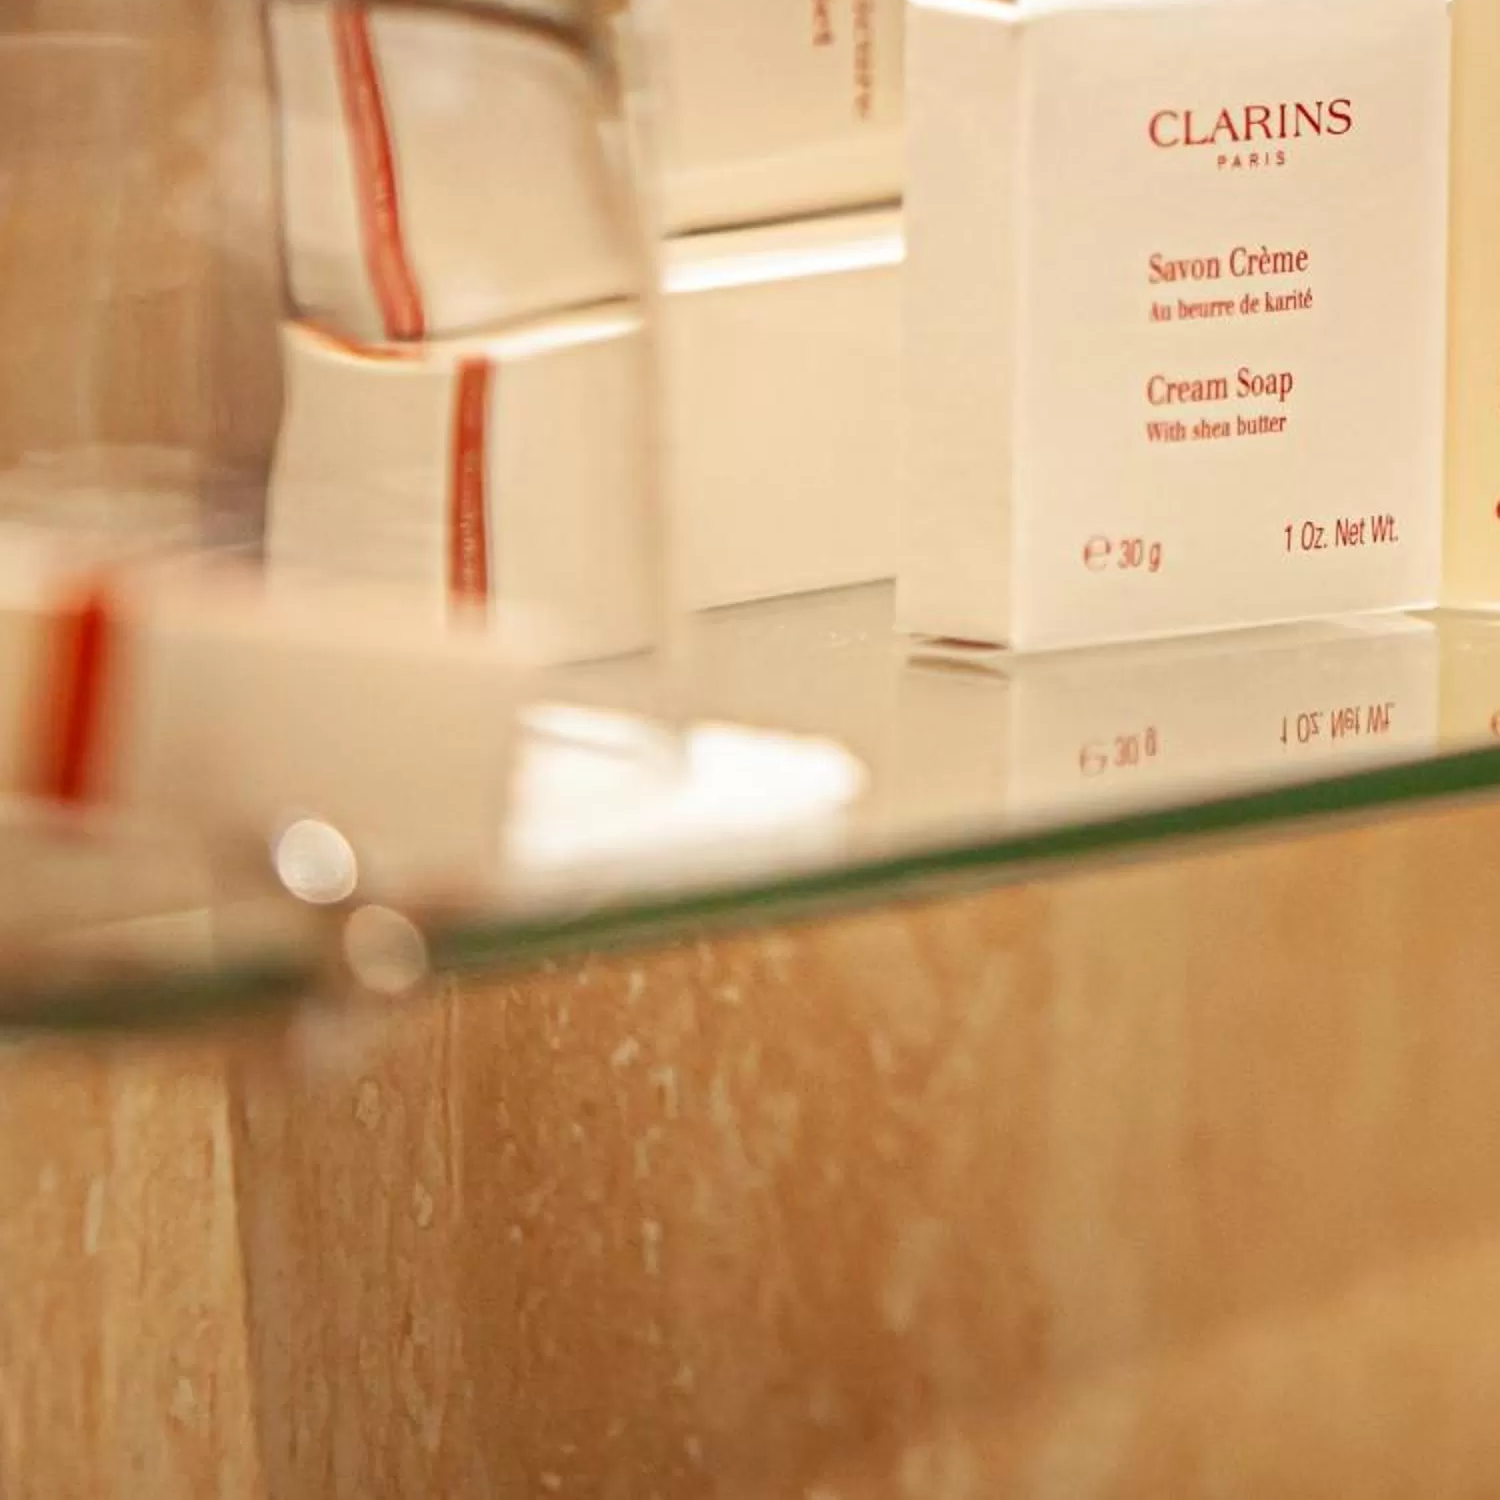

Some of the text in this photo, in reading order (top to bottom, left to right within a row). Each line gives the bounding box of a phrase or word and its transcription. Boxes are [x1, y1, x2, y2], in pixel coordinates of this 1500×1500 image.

[1147, 98, 1354, 149] CLARINS
[1216, 149, 1287, 169] PARIS
[1147, 243, 1309, 285] Savon Crème
[1149, 286, 1314, 323] Au beurre de karité
[1146, 365, 1295, 406] Cream Soap
[1145, 412, 1289, 444] With shea butter
[1283, 513, 1399, 554] 1 Oz. Net Wt.
[1117, 536, 1144, 571] 30
[1148, 540, 1163, 574] g
